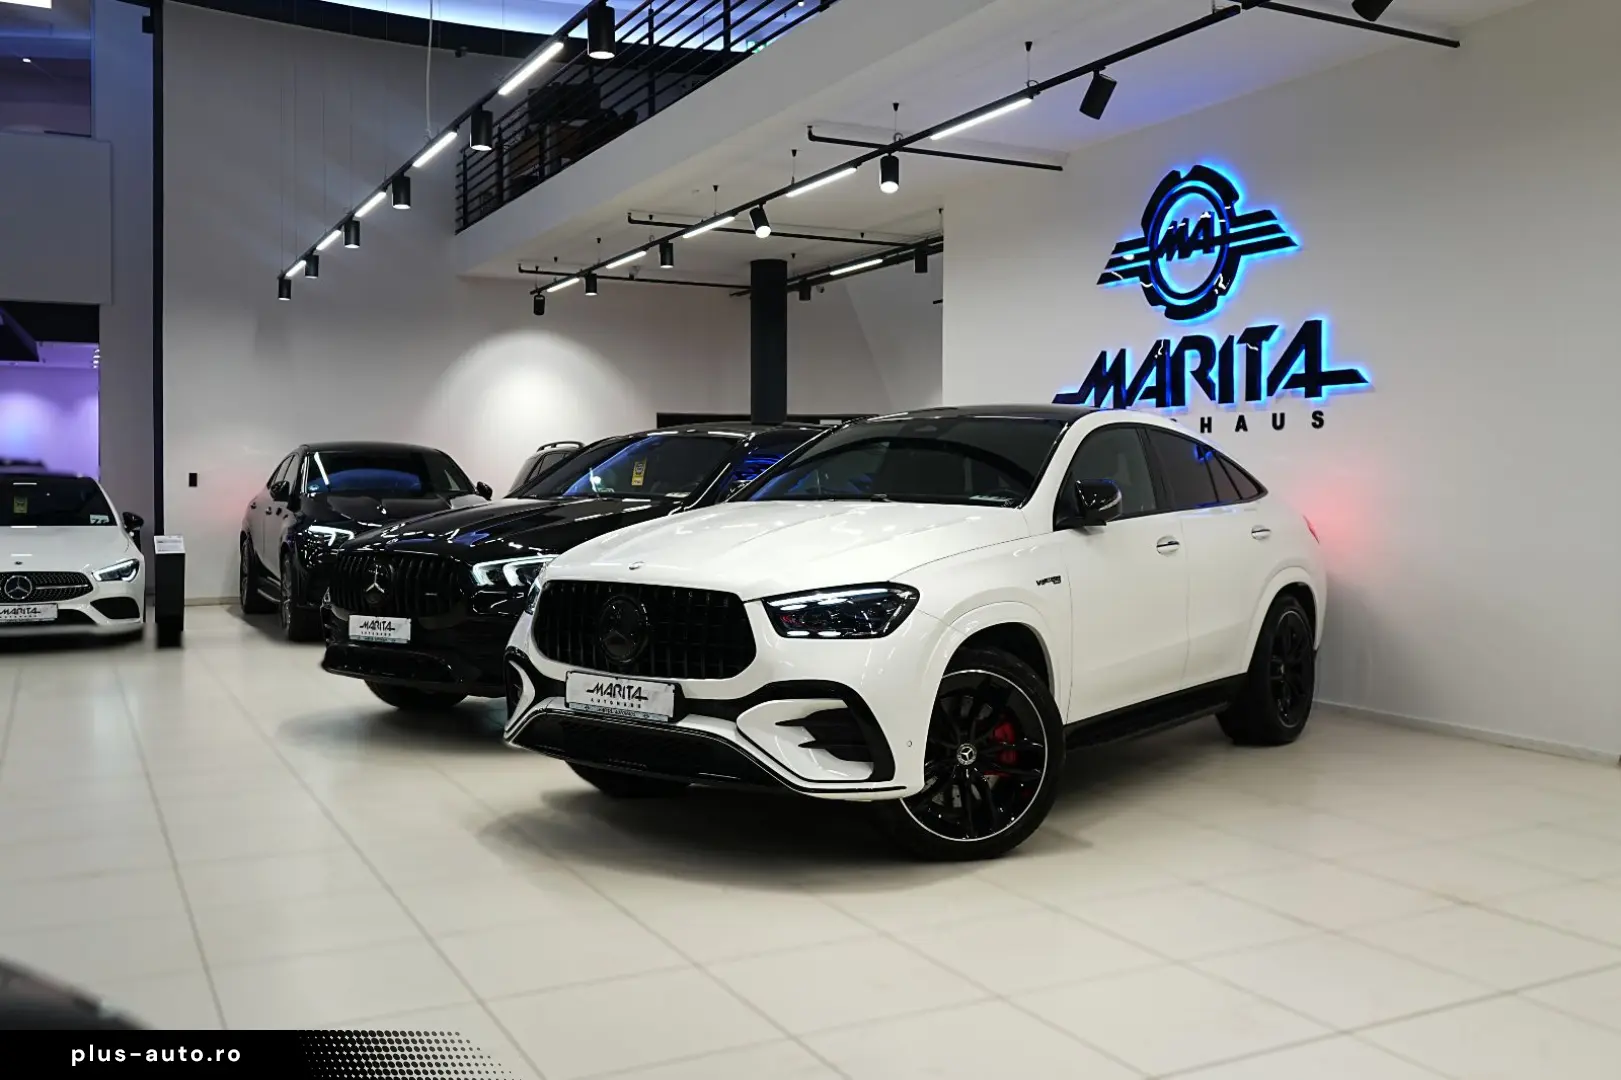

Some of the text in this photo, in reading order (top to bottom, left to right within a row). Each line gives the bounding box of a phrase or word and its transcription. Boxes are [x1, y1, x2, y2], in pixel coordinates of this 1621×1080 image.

[1052, 319, 1369, 410] MARITA
[1200, 410, 1325, 434] HAUS
[359, 619, 396, 632] MARITA
[586, 682, 649, 702] MARITA
